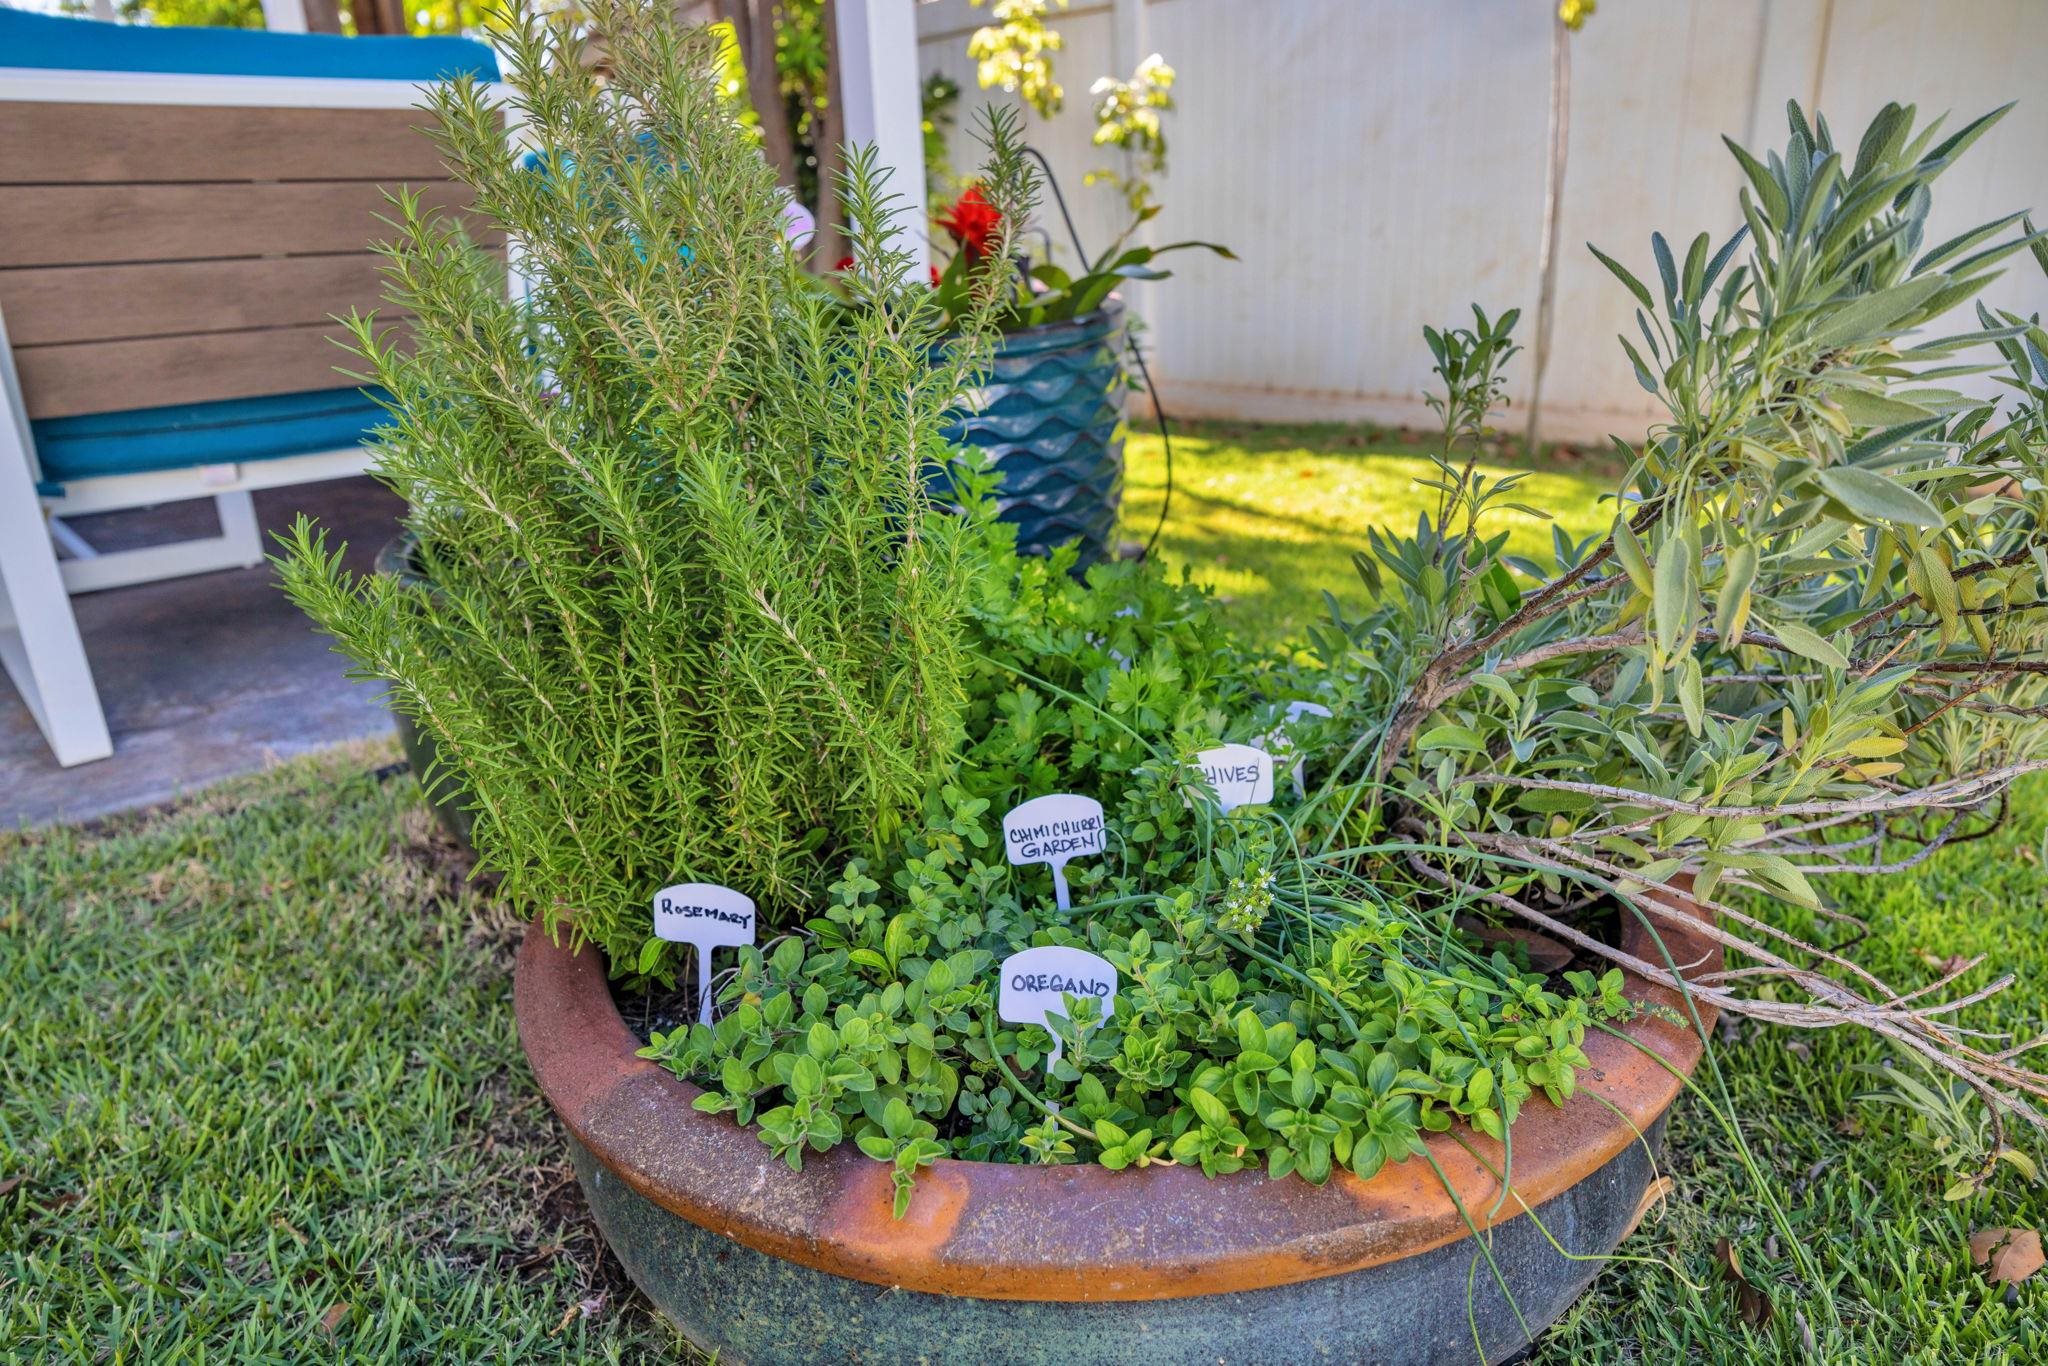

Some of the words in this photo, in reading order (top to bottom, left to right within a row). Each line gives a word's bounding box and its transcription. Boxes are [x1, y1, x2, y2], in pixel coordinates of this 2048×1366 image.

[1204, 765, 1260, 785] HIVES
[1009, 815, 1102, 844] CHIMICHURRI
[1021, 832, 1095, 858] GARDEN
[661, 898, 752, 929] ROSEMARY
[1011, 974, 1110, 998] OREGANO
